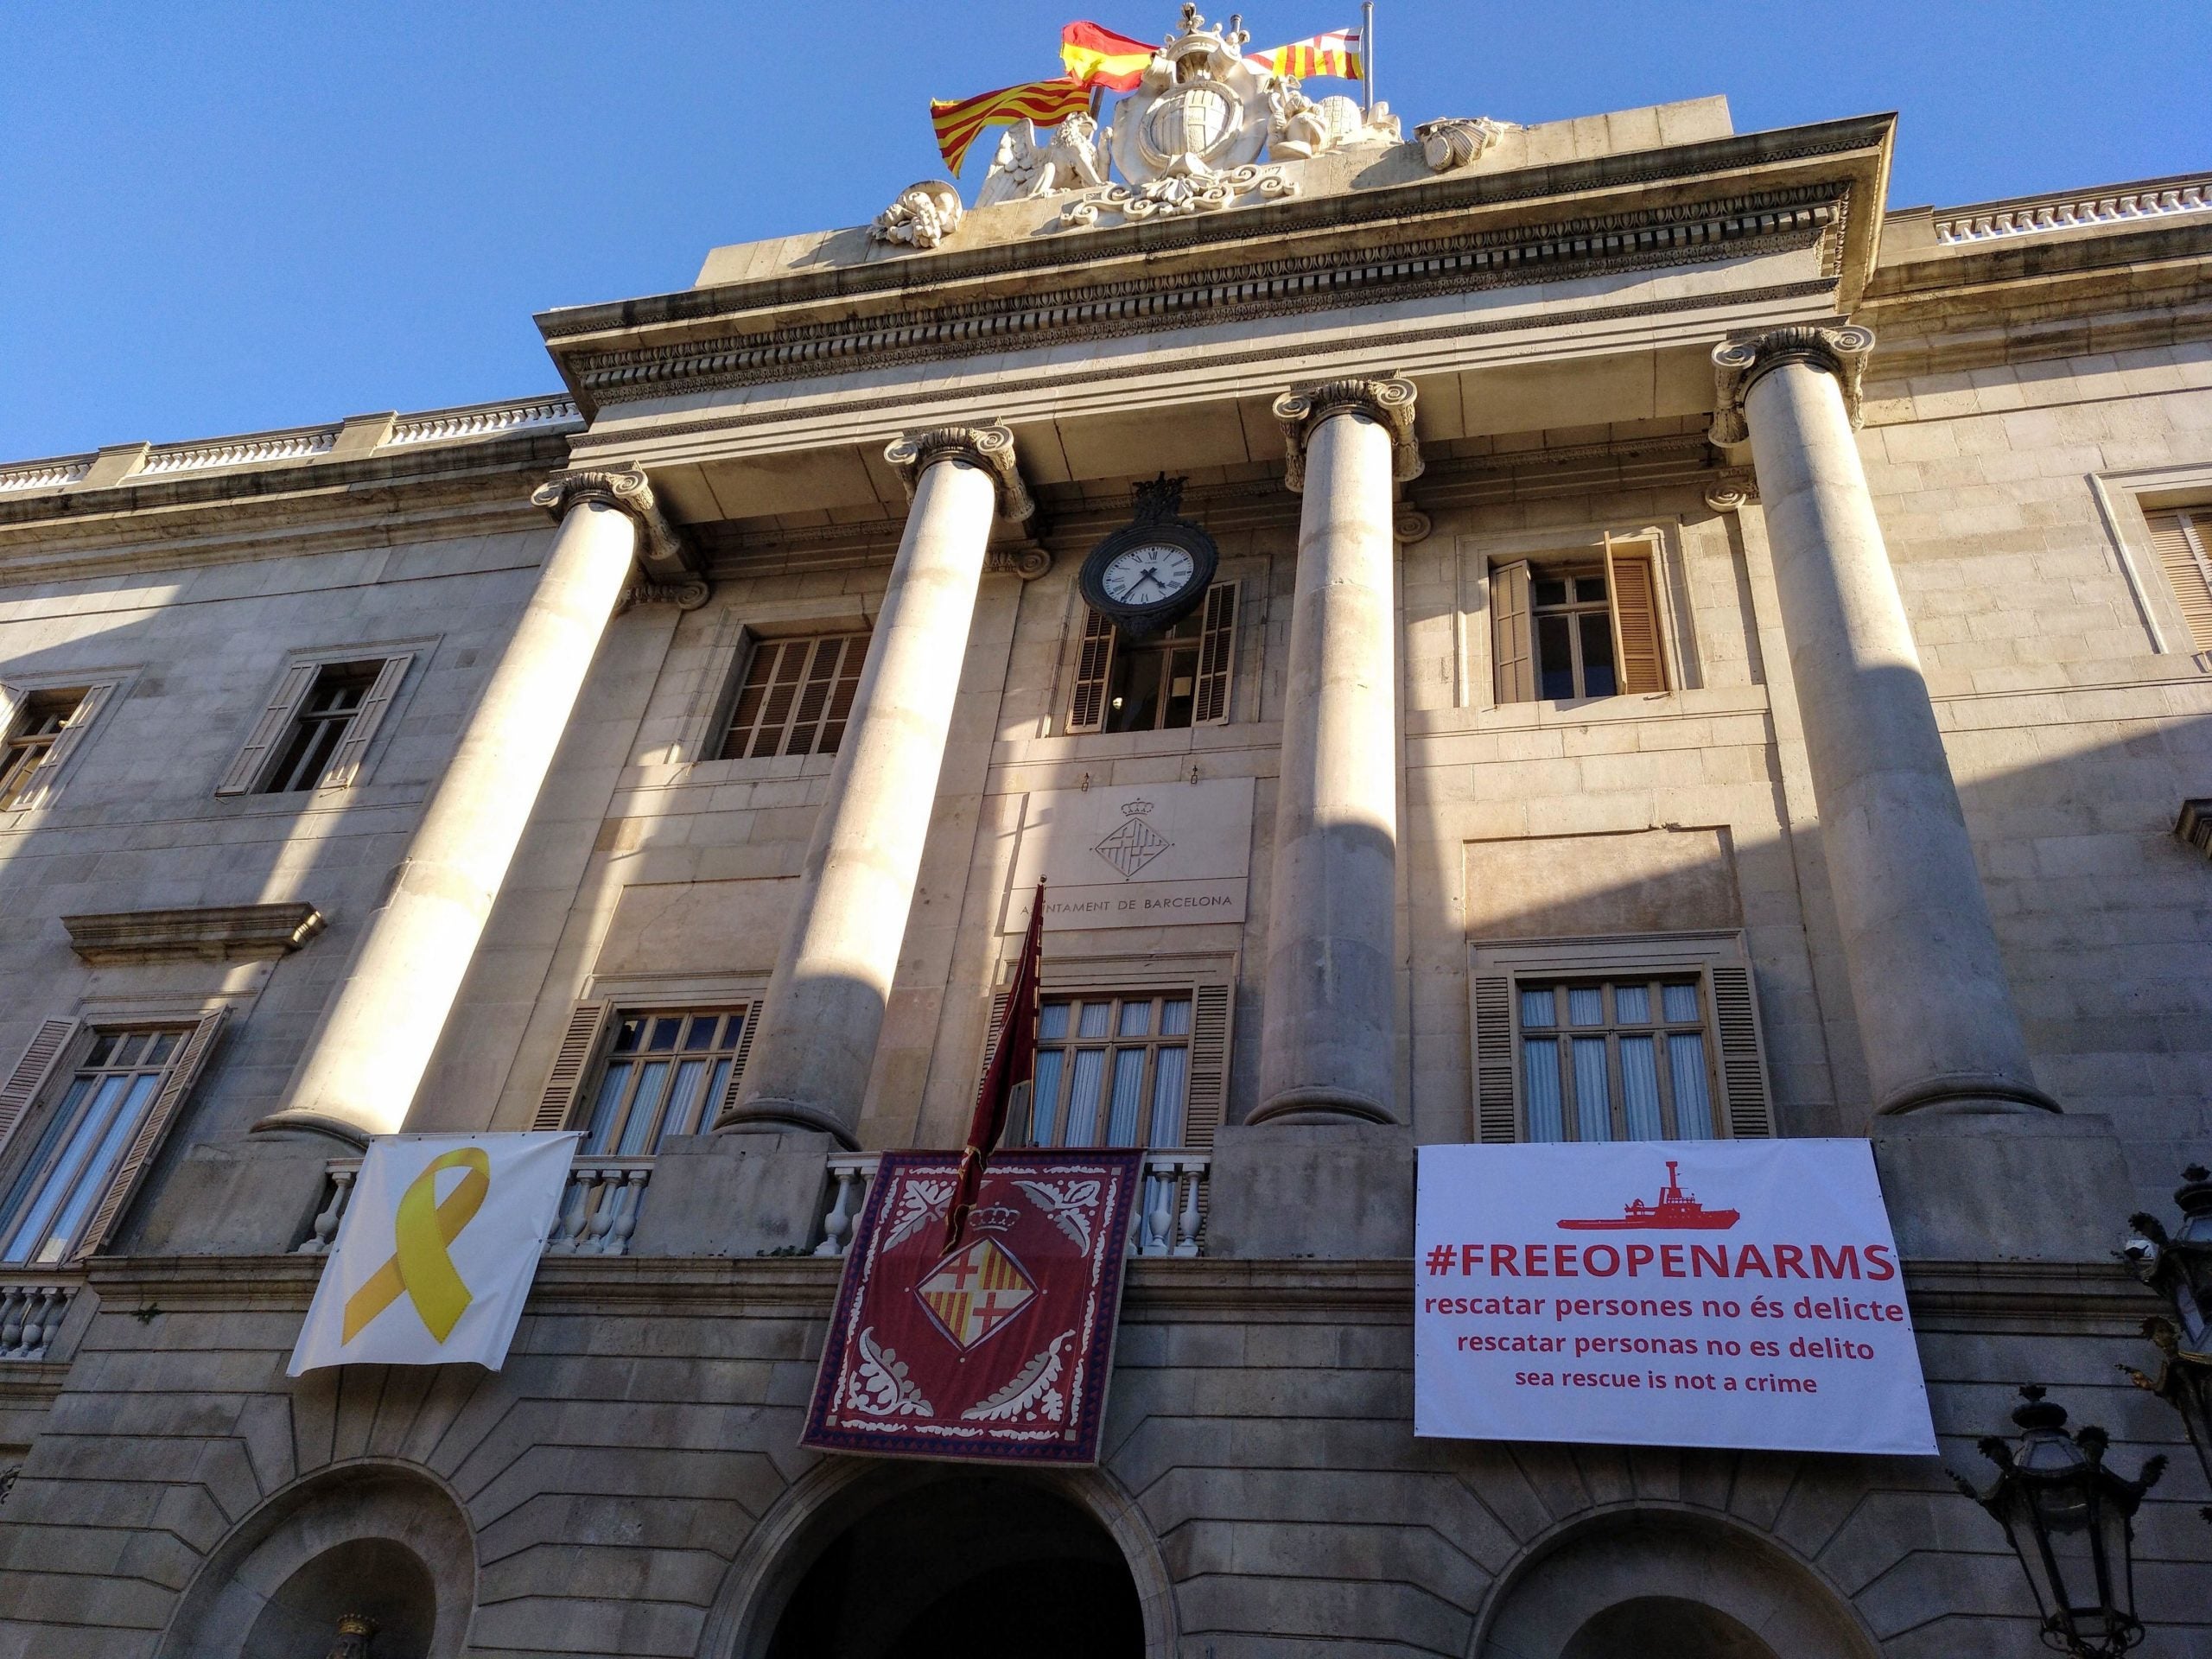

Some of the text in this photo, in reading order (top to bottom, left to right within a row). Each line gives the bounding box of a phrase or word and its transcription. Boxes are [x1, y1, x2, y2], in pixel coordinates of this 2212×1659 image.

[1020, 896, 1232, 915] ANTAMENT DE BARCELONA
[1426, 1244, 1895, 1281] #FREEOPENARMS
[1426, 1295, 1904, 1321] rescatar persones no és delicte
[1459, 1335, 1873, 1359] rescatar personas no es delito
[1516, 1370, 1816, 1392] sea rescue is not a crime
